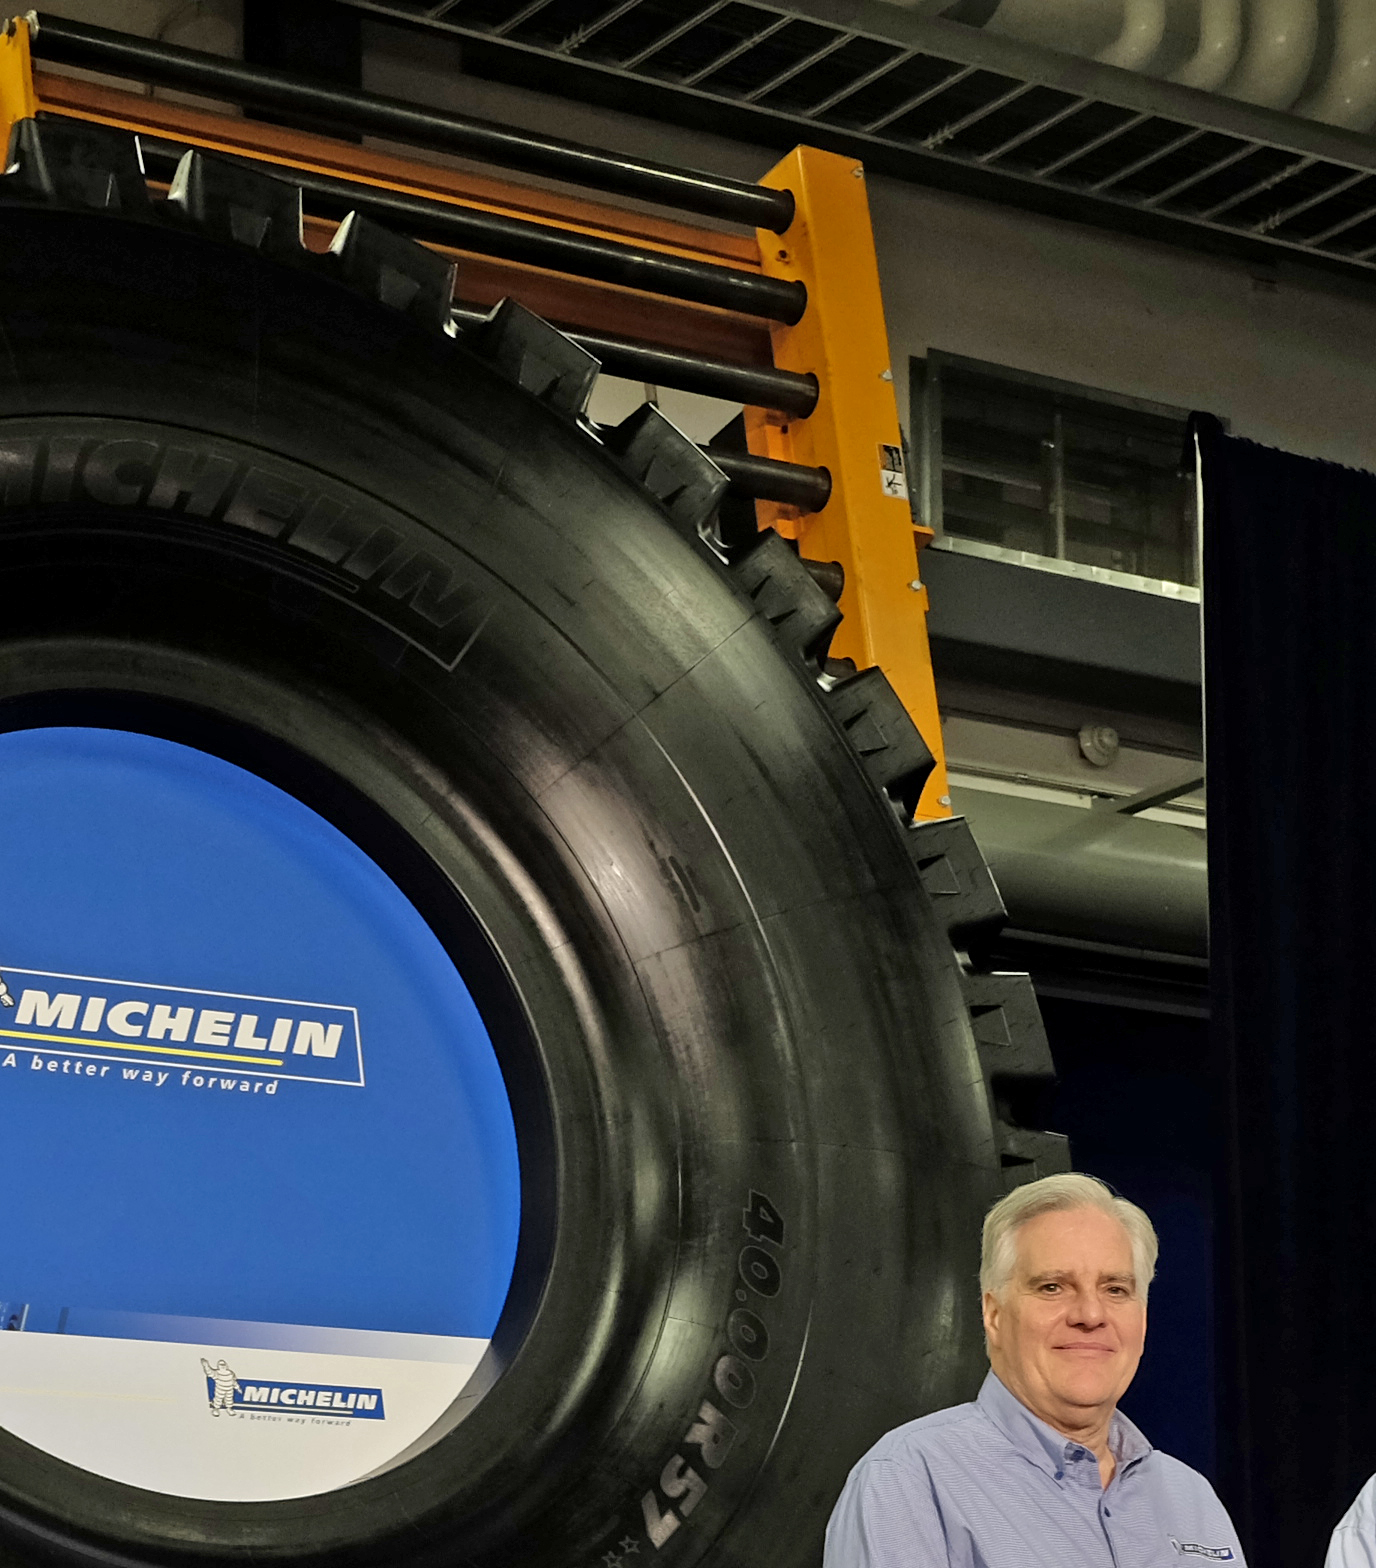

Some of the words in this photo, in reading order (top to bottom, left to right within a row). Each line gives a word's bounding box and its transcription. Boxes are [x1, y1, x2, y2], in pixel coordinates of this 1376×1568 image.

[14, 989, 343, 1059] MICHELIN
[2, 1053, 17, 1068] A
[31, 1055, 110, 1078] better
[122, 1068, 170, 1087] way
[181, 1071, 279, 1095] forward
[243, 1385, 378, 1410] MICHELIN
